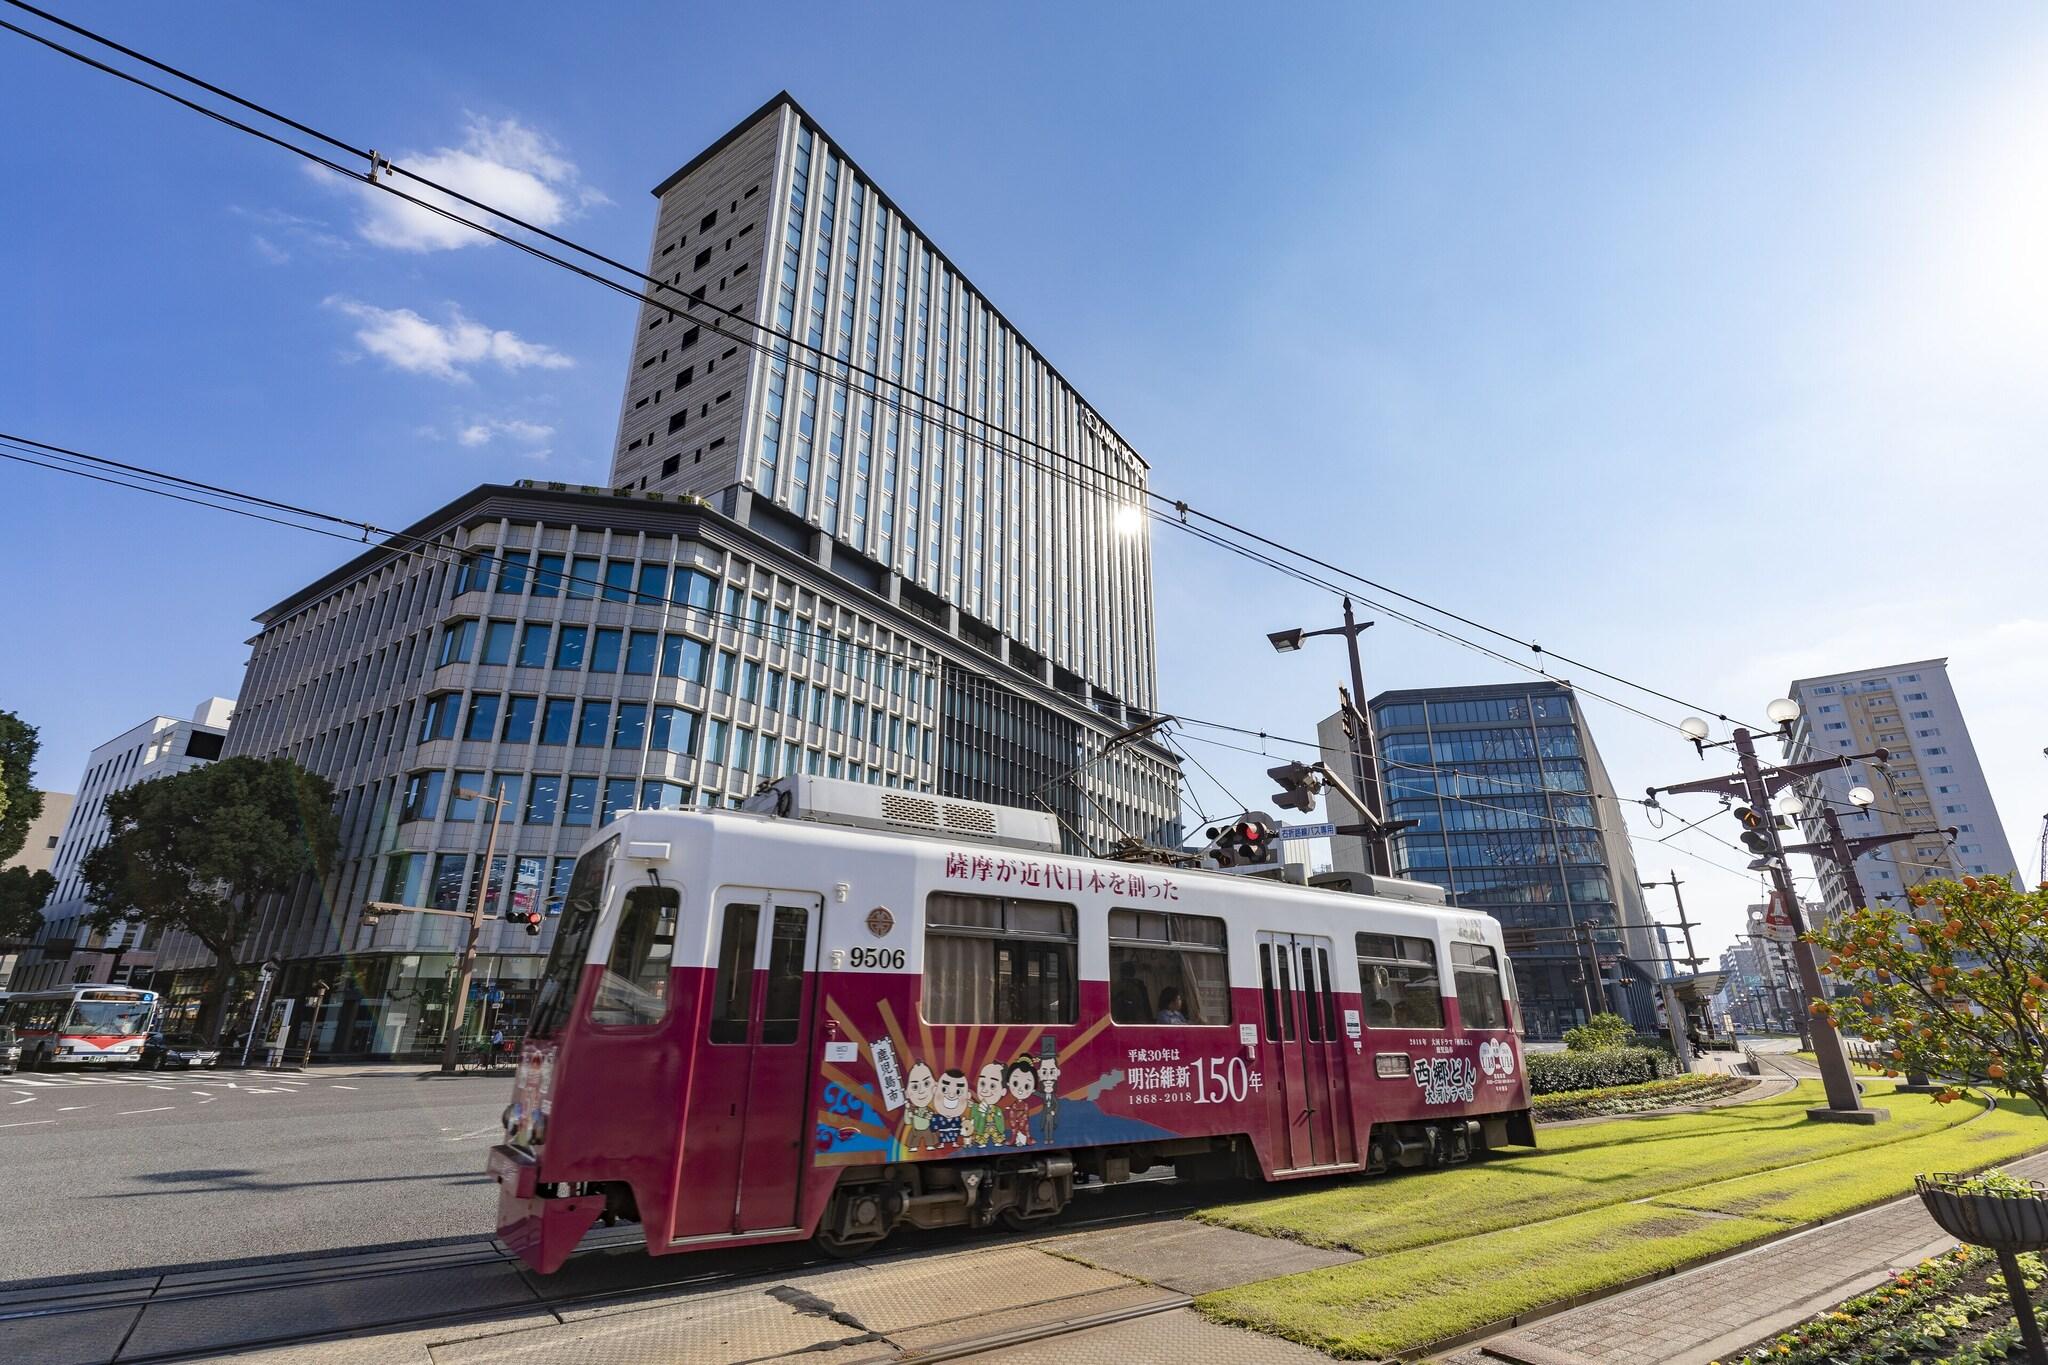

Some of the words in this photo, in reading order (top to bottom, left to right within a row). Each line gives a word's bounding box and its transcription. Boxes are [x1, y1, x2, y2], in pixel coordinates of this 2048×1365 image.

[945, 852, 1179, 900] 薩摩が近代日本を創った
[850, 947, 905, 969] 9506
[1128, 1048, 1180, 1062] 平成30年は
[876, 1048, 899, 1102] 鹿児島市
[1414, 1058, 1477, 1087] 西郷どん
[1129, 1092, 1192, 1105] 1868-2018
